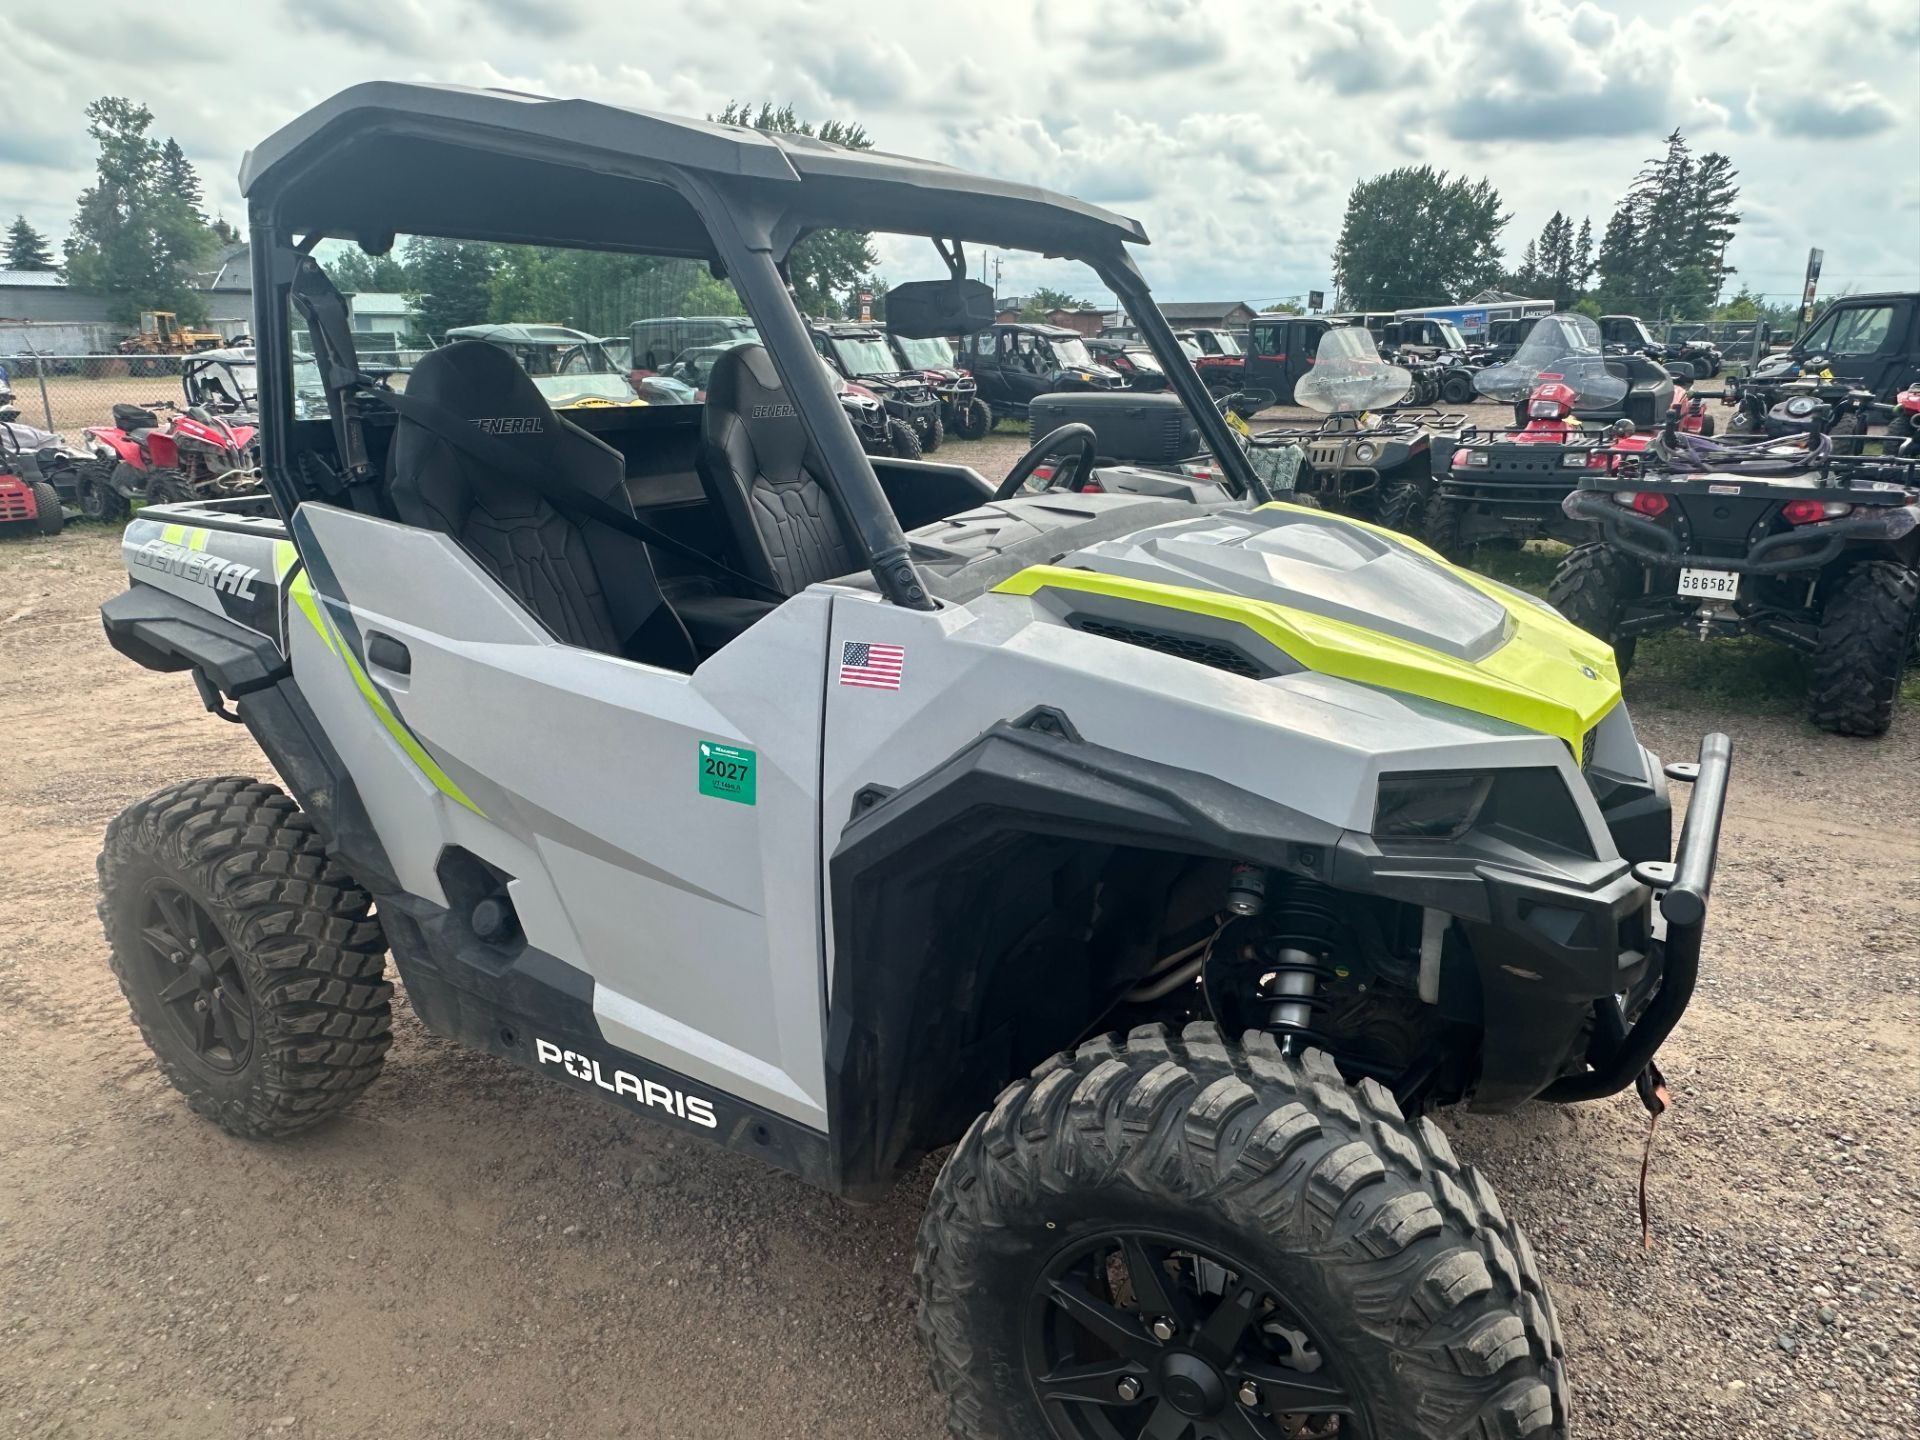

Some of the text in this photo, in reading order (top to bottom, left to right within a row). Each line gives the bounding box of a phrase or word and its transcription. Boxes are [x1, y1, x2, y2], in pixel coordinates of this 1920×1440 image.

[752, 404, 798, 419] GENERA
[133, 538, 261, 602] GENERAL
[1682, 576, 1735, 592] 5865BZ
[705, 757, 748, 782] 2027
[535, 1037, 718, 1129] POLARIS
